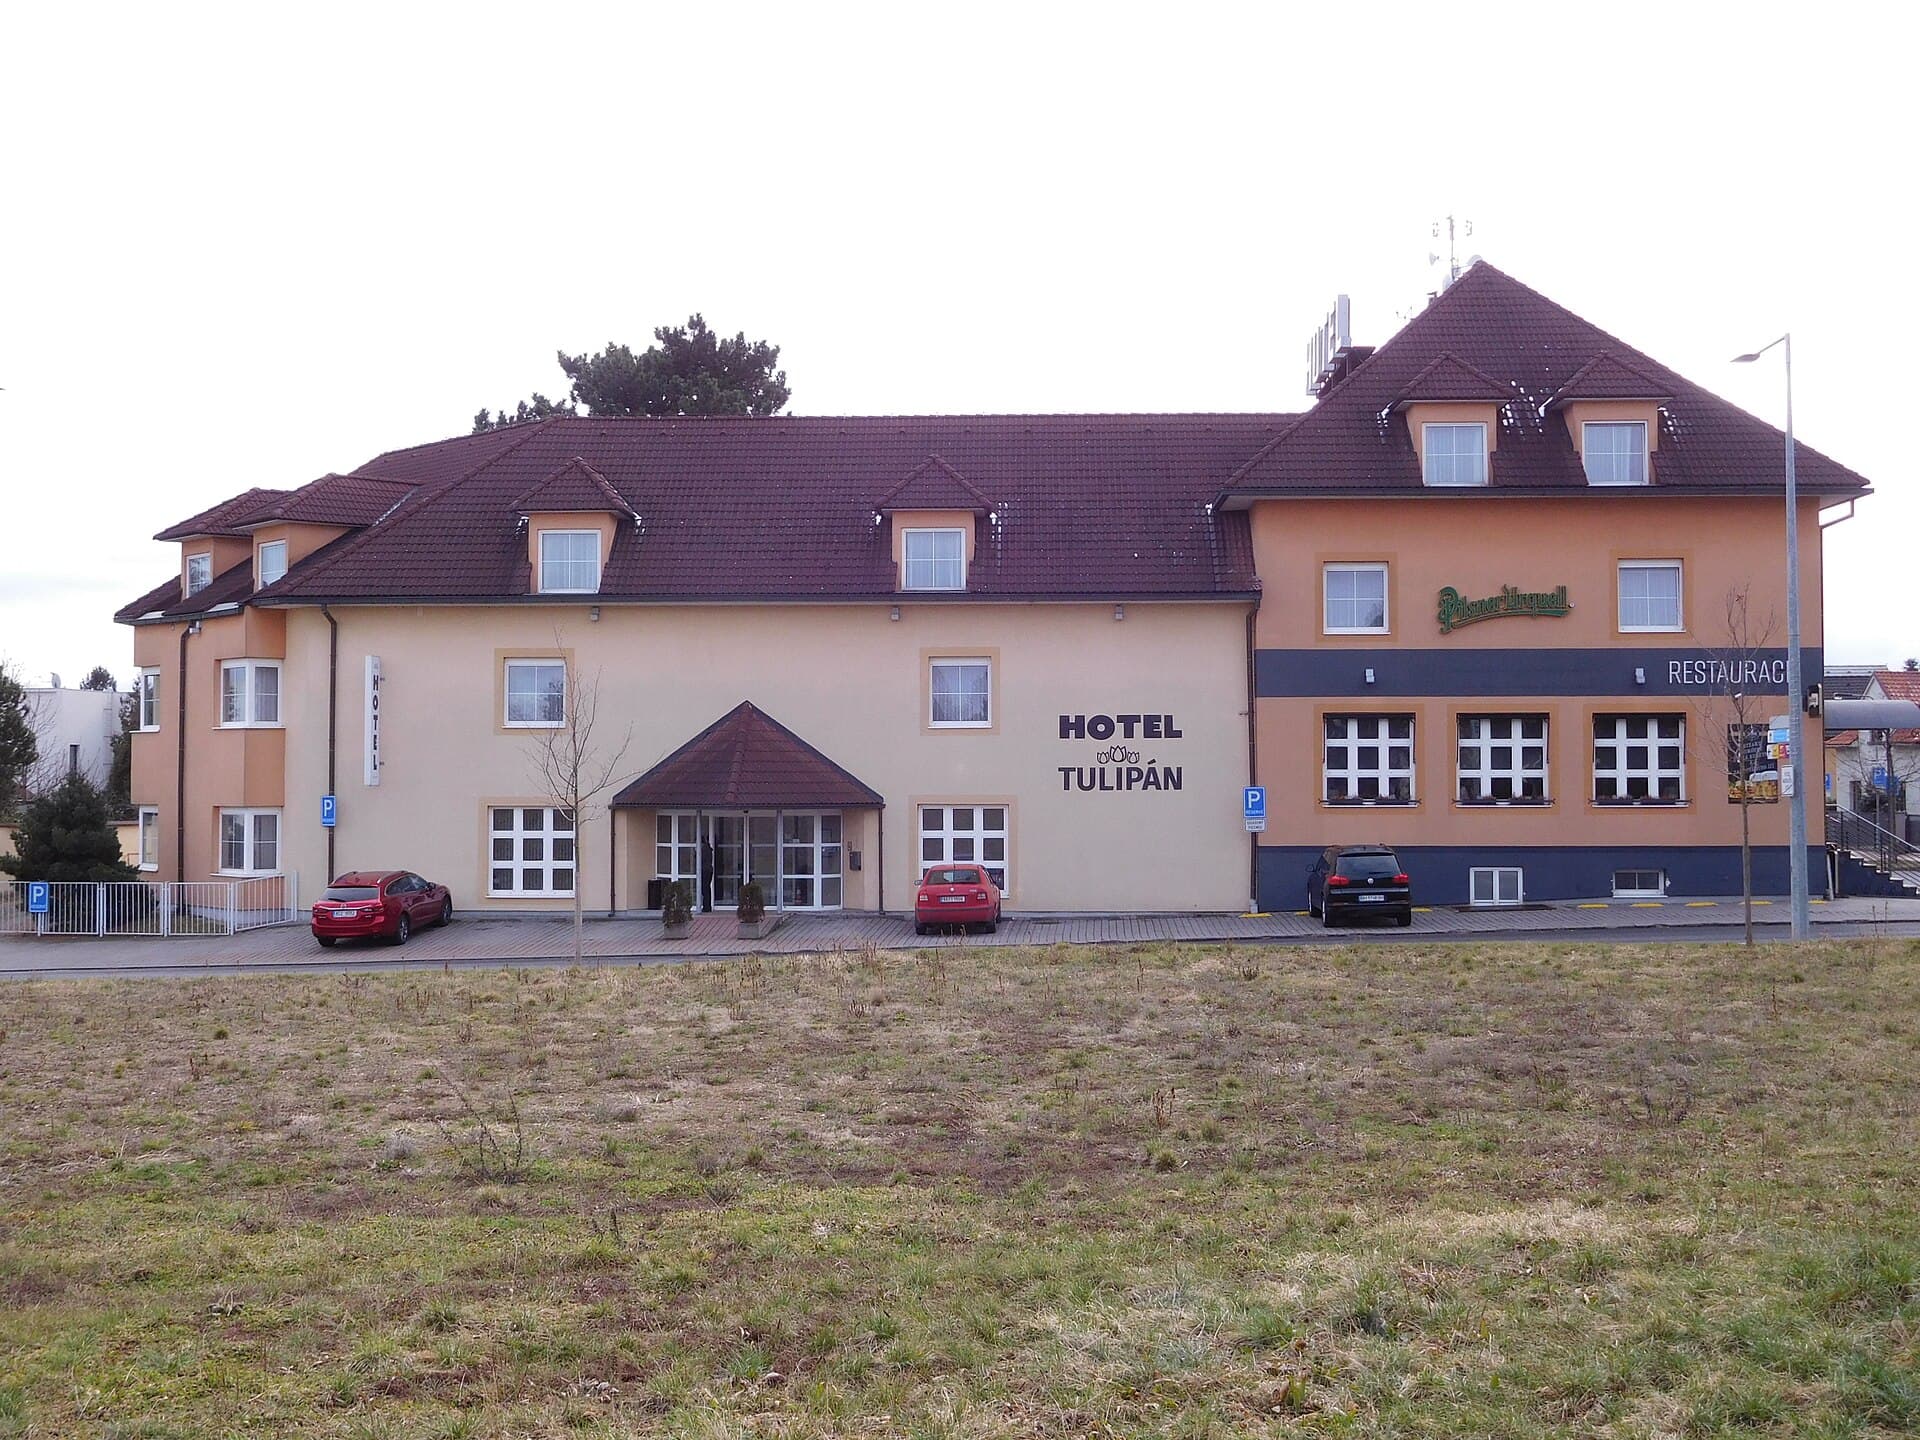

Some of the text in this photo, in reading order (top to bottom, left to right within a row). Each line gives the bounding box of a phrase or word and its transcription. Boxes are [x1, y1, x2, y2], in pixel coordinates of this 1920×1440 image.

[1438, 583, 1567, 634] Pilsner Urquell
[1669, 660, 1790, 684] RESTAURAC
[1059, 714, 1182, 740] HOTEL
[1058, 758, 1182, 791] TULIPÁN
[324, 799, 333, 817] P
[1248, 791, 1260, 809] P
[33, 885, 44, 903] P
